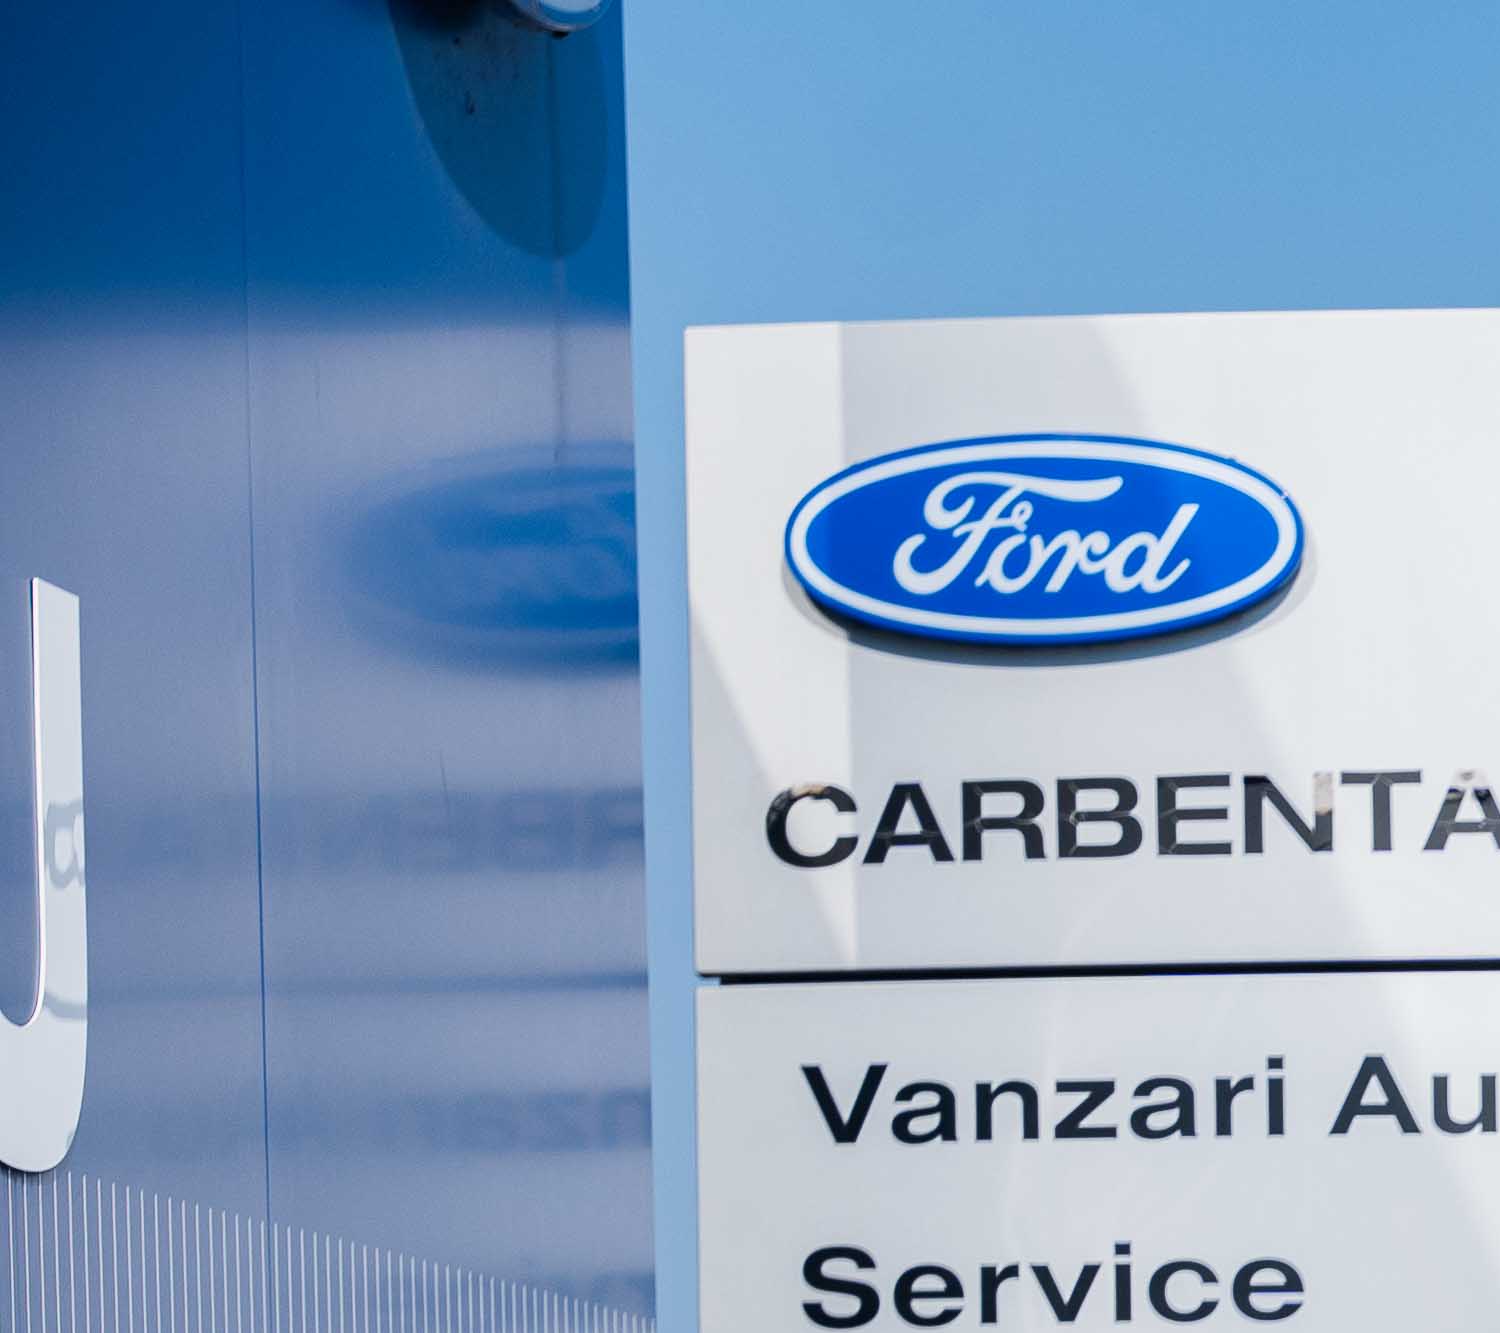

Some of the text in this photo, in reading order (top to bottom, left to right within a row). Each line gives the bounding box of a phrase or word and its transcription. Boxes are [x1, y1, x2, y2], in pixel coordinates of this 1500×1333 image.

[893, 472, 1199, 595] Ford
[801, 1056, 1285, 1145] Vanzari
[803, 1242, 1305, 1330] Service
